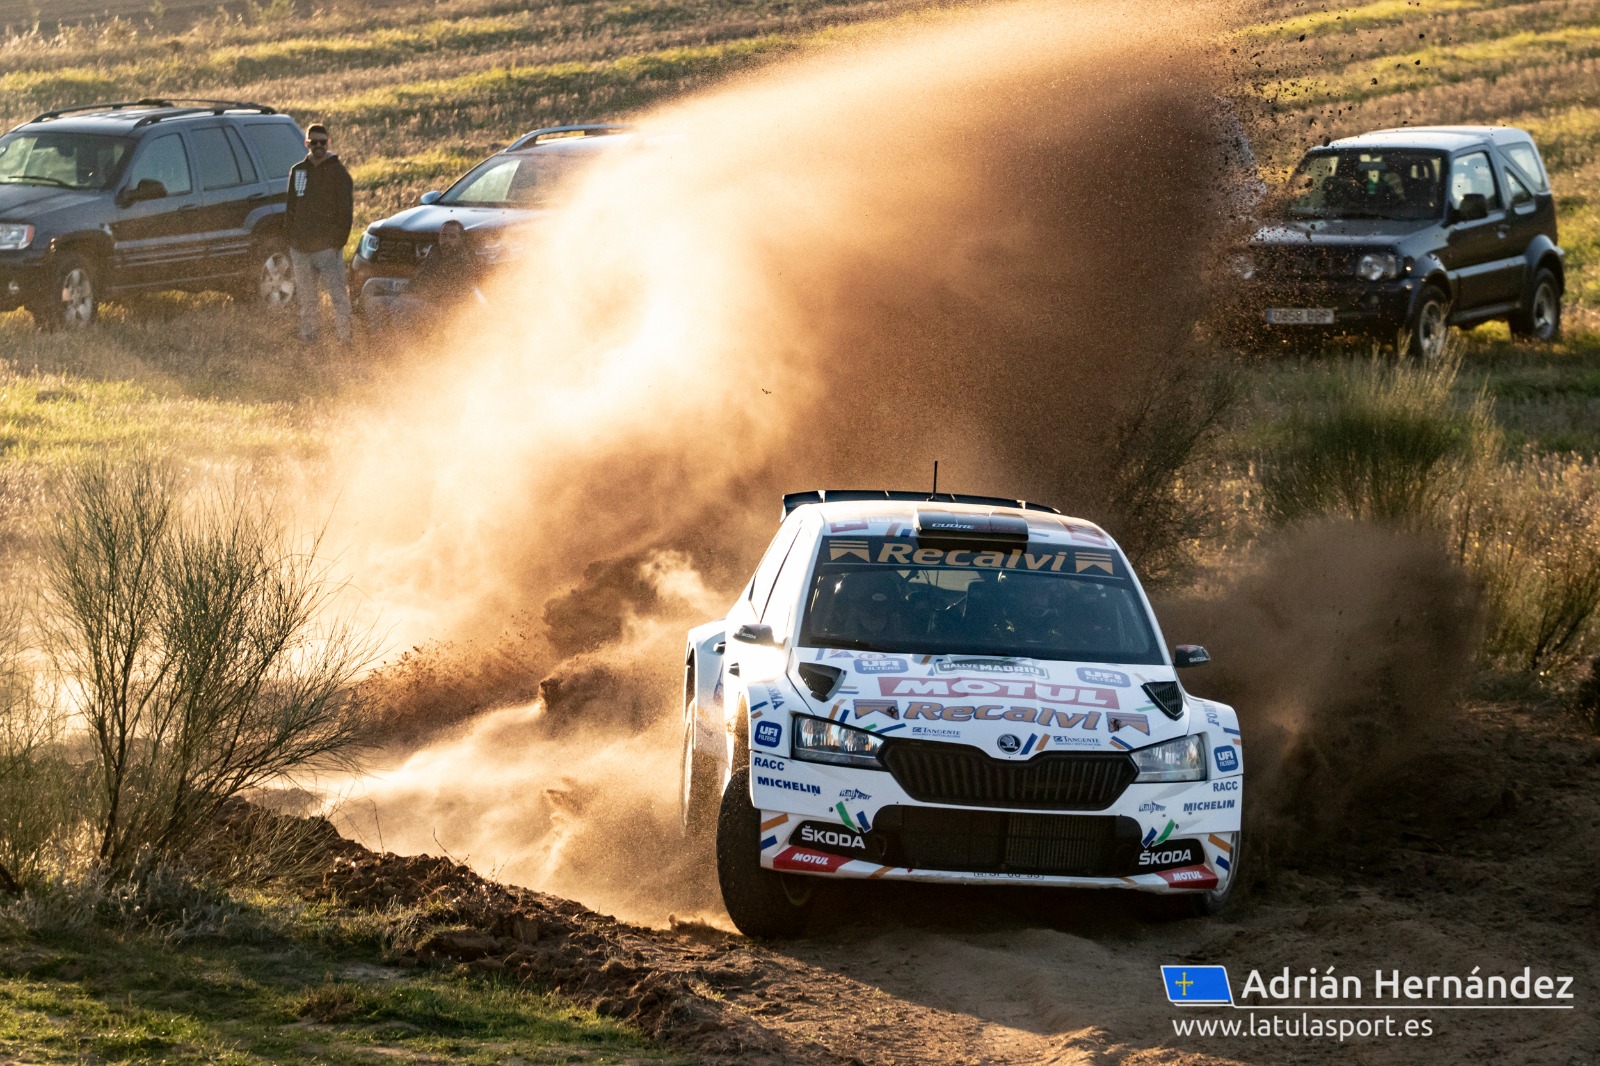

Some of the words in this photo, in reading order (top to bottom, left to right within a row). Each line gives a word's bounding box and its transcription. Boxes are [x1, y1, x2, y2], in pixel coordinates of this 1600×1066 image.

[877, 542, 1067, 572] Recalvi
[979, 664, 1040, 675] MADRID
[1084, 670, 1122, 681] UFI
[1086, 676, 1123, 684] FILTERS
[893, 679, 1109, 705] MOTUL
[902, 701, 1102, 731] Recalvi
[759, 726, 779, 737] UFI
[757, 734, 777, 743] FILTERS
[1216, 750, 1234, 761] UFI
[754, 757, 785, 771] RACC
[1219, 759, 1236, 767] FILTERS
[757, 776, 821, 794] MICHELIN
[1213, 781, 1239, 792] RACC
[1183, 800, 1236, 812] MICHELIN
[801, 825, 866, 849] ŠKODA
[792, 853, 829, 865] MOTUL
[1138, 849, 1192, 866] ŠKODA
[1173, 871, 1203, 881] MOTUL
